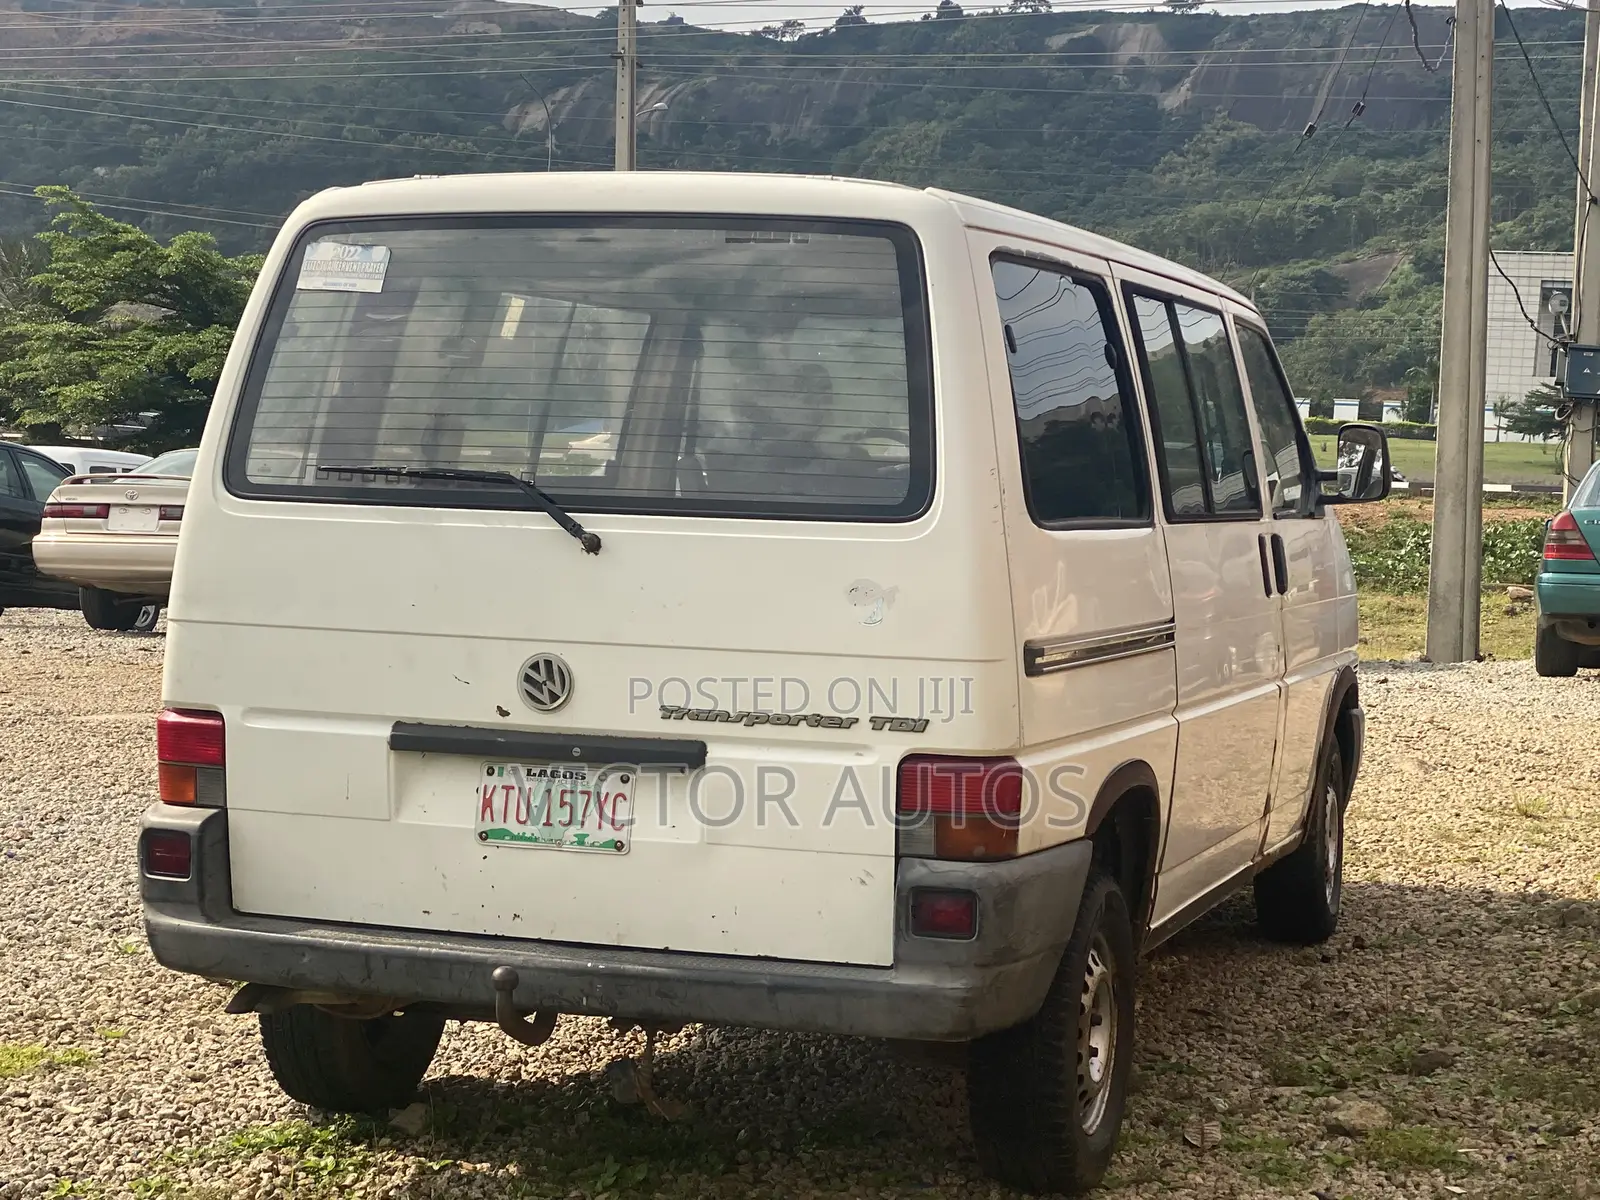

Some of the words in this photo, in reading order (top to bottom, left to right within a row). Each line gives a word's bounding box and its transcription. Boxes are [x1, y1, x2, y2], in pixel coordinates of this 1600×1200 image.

[331, 245, 361, 260] 2022
[361, 262, 384, 273] PRAYER
[659, 705, 860, 729] Transporter
[869, 716, 930, 733] TDI
[525, 768, 587, 780] LAGOS
